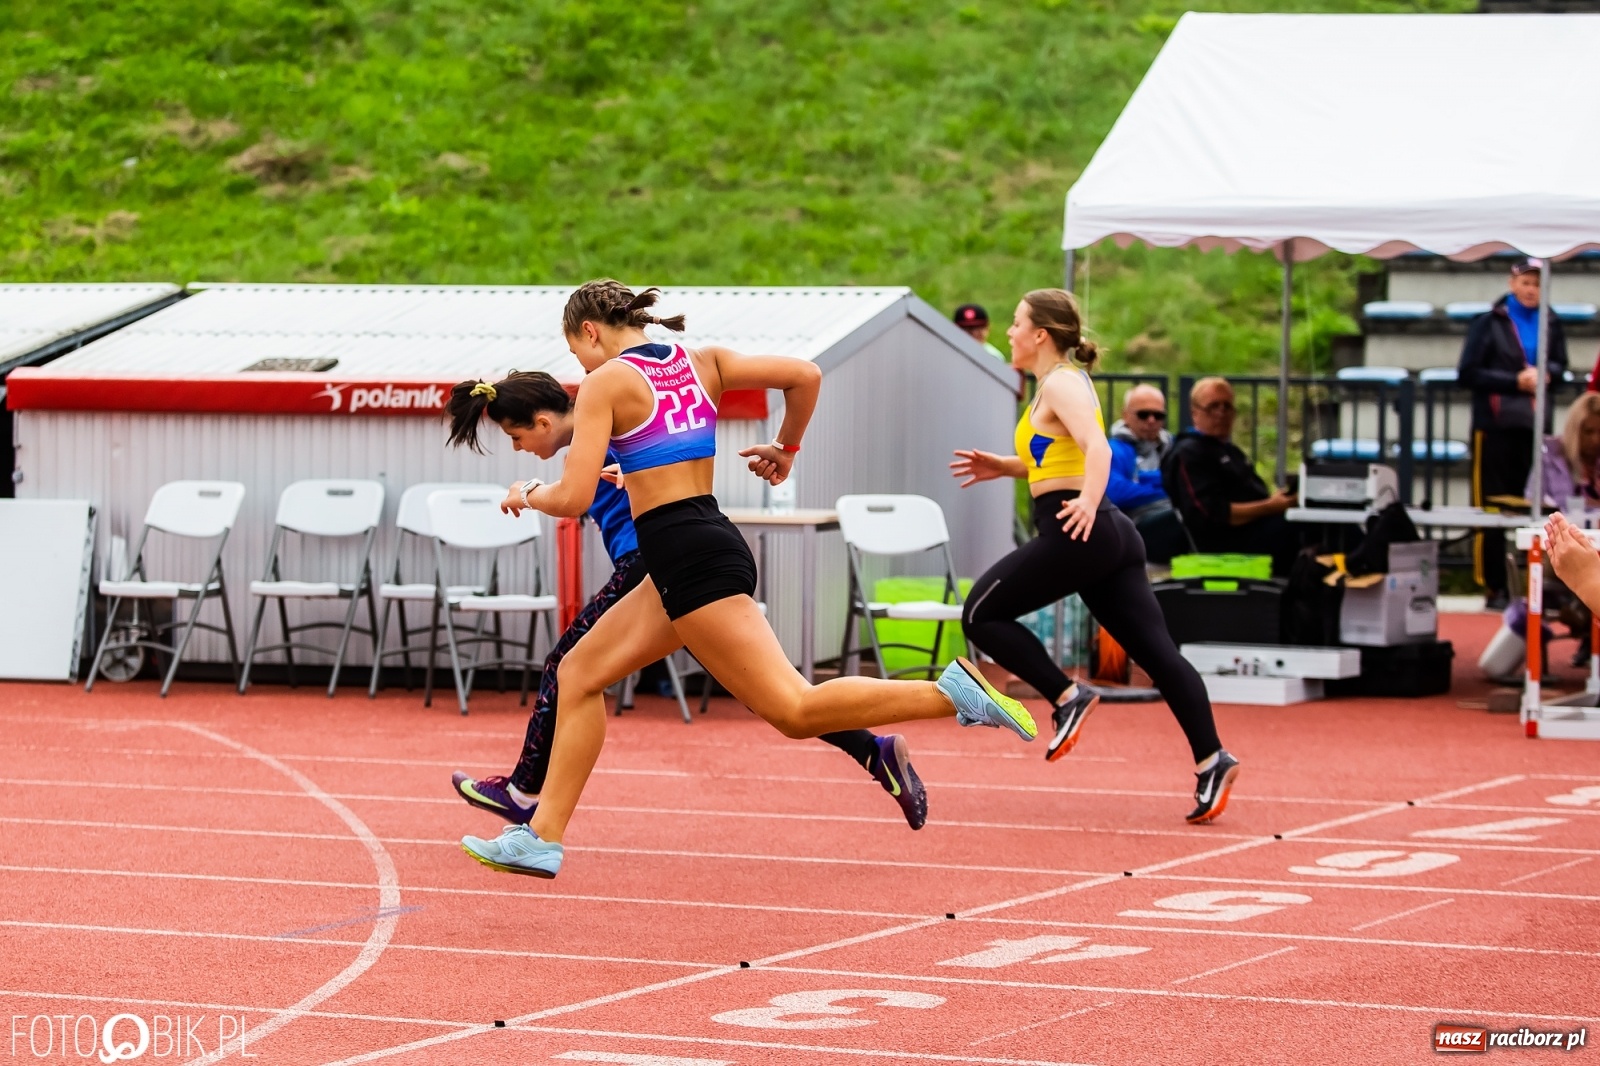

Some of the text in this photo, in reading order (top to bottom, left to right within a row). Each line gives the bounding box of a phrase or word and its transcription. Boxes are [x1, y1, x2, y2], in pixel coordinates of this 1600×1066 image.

[350, 383, 445, 413] polanik
[656, 384, 707, 434] 22
[1117, 890, 1313, 922] 5
[936, 934, 1152, 968] 4
[710, 989, 947, 1030] 3
